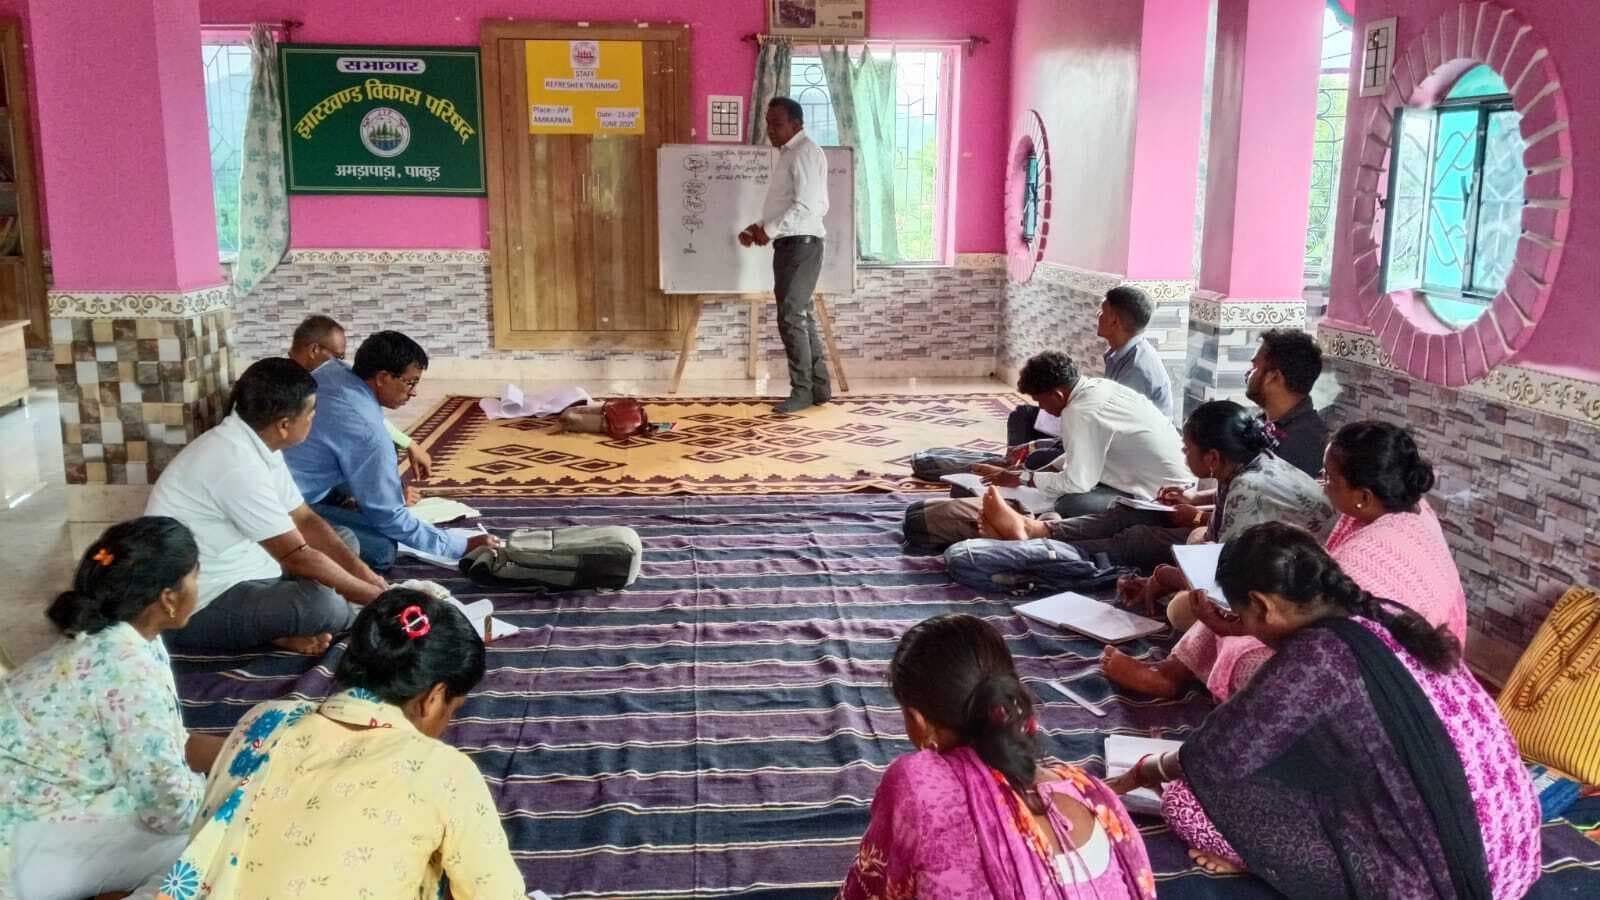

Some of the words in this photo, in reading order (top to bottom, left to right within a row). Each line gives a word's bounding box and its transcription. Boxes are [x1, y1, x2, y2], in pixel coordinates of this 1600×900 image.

[545, 80, 584, 89] REFRESHER
[364, 78, 421, 106] विकास
[425, 94, 476, 145] परिषद
